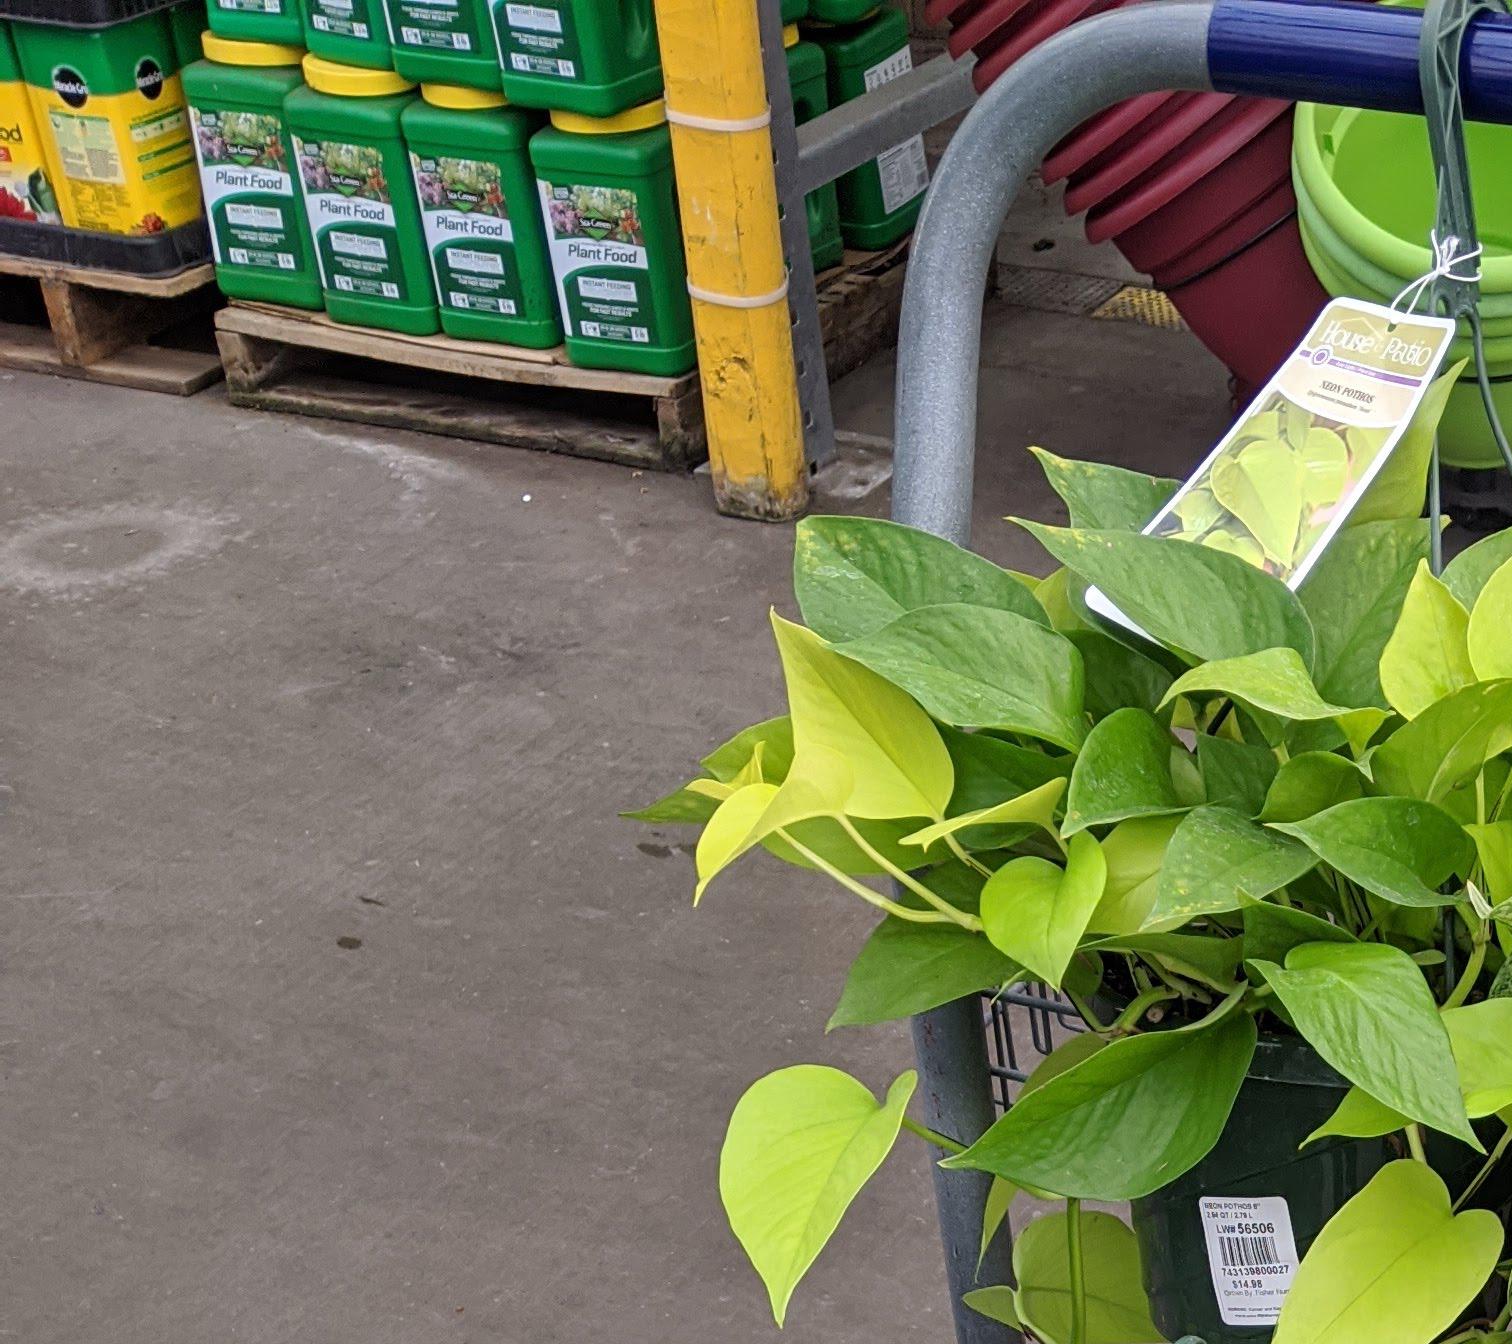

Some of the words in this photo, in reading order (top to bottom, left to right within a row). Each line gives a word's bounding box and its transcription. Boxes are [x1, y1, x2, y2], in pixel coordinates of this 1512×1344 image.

[0, 123, 23, 143] od
[216, 171, 248, 187] Plant
[250, 175, 282, 190] Food
[320, 200, 351, 216] Plant
[354, 205, 385, 221] Food
[436, 216, 468, 233] Plant
[471, 220, 503, 236] Food
[568, 244, 601, 260] Plant
[604, 249, 637, 263] Food
[1319, 320, 1375, 353] House
[1379, 337, 1432, 367] Patio
[1320, 380, 1341, 394] NEON
[1341, 387, 1375, 404] POTHOS
[1237, 1222, 1275, 1234] 56506
[1221, 1264, 1290, 1277] 743139800027
[1232, 1279, 1263, 1289] $14.98
